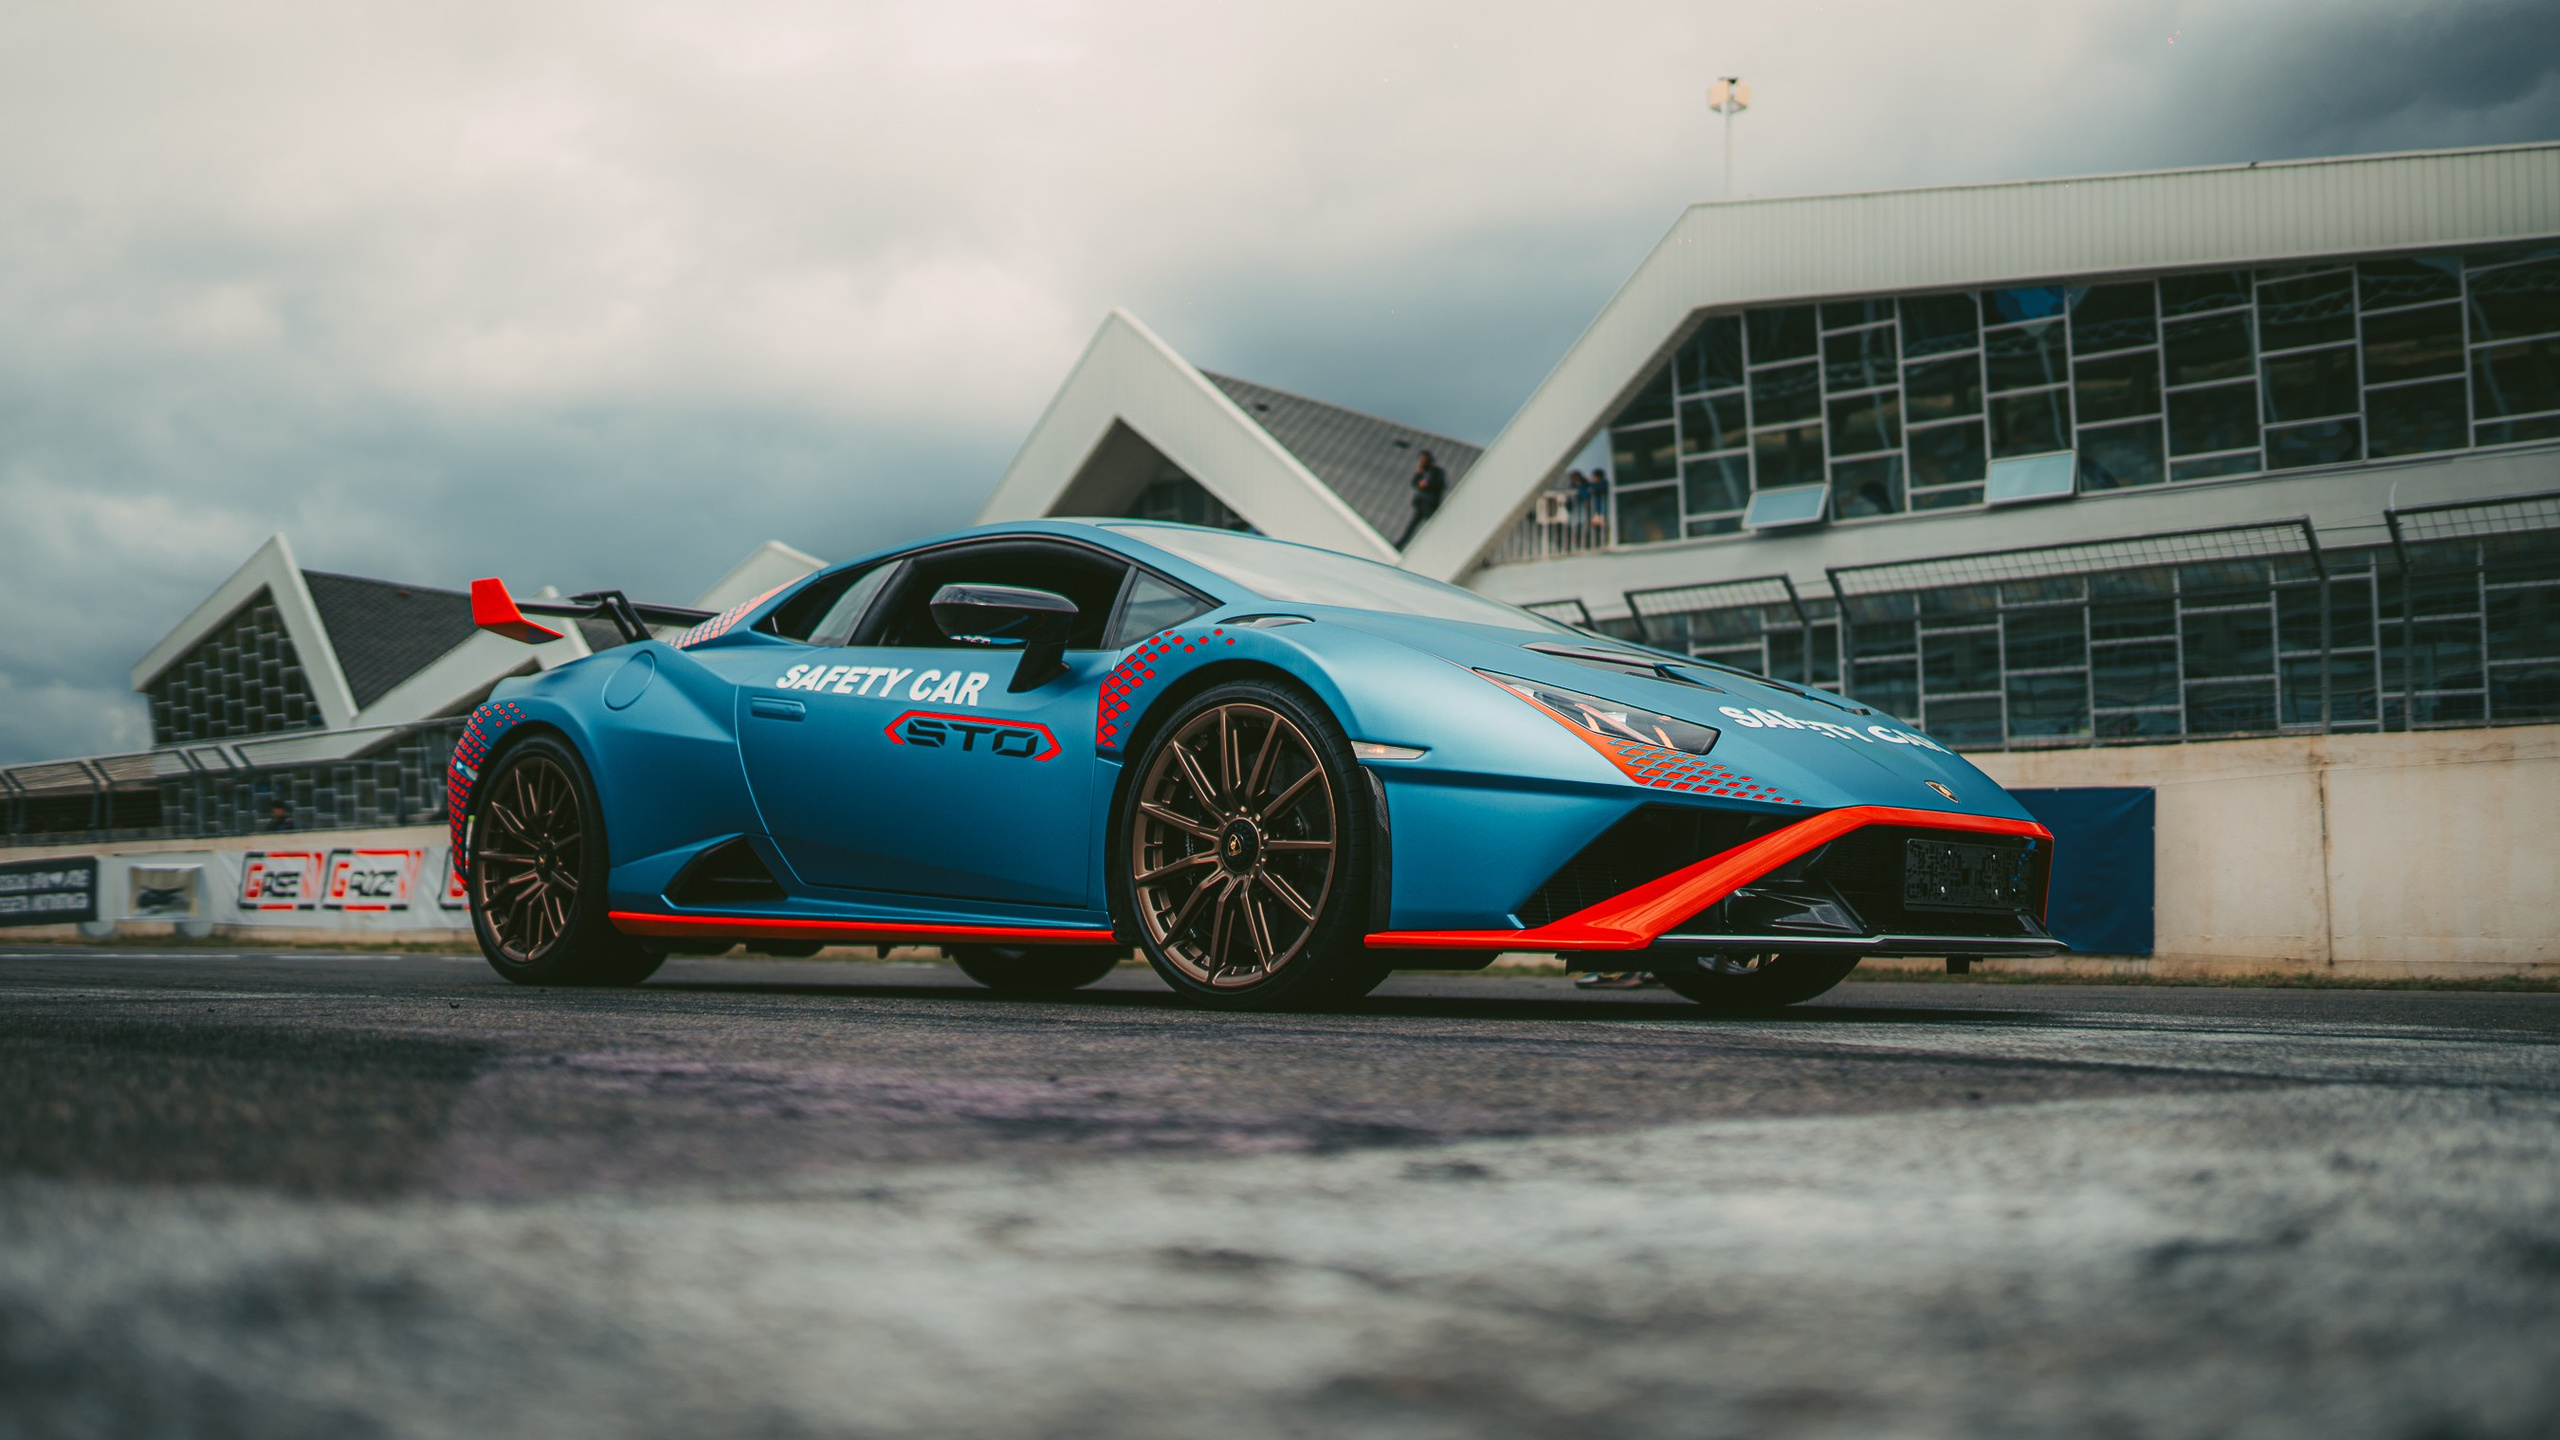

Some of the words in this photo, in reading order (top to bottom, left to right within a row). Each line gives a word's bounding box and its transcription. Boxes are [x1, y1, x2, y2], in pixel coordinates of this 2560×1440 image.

[775, 664, 913, 698] SAFETY
[909, 670, 989, 707] CAR
[905, 719, 1039, 758] STO
